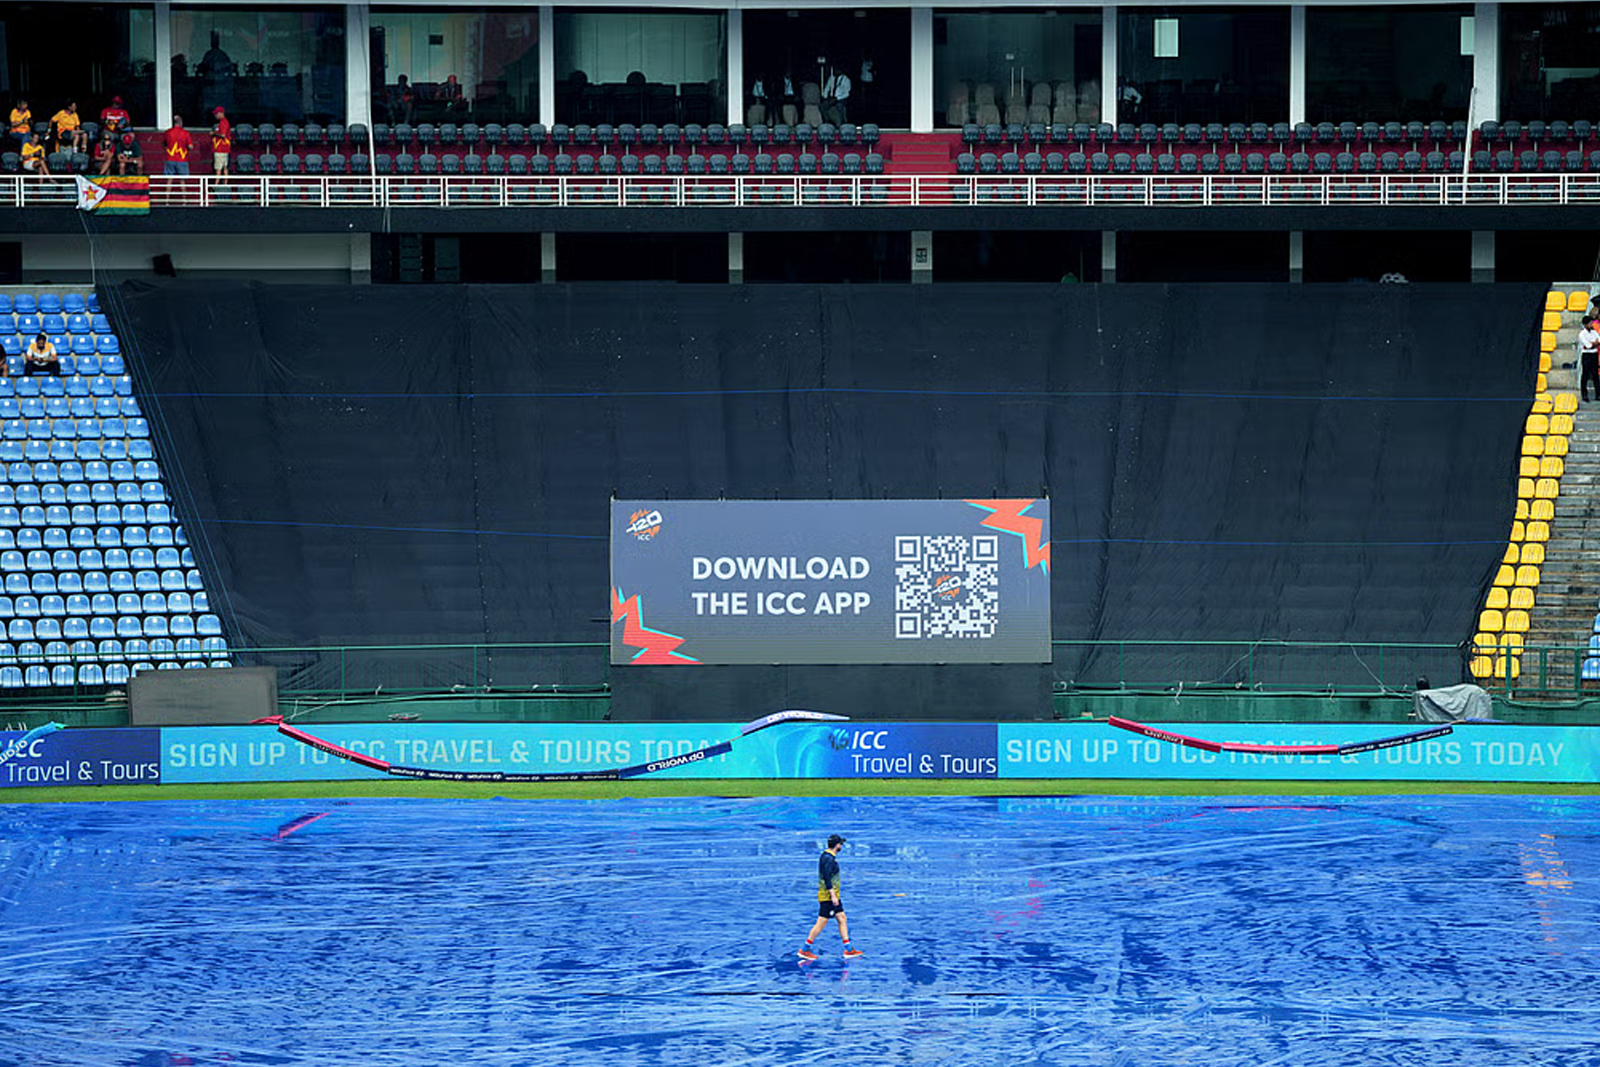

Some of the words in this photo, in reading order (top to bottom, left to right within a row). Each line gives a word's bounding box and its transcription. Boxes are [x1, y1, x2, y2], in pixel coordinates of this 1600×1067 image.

[692, 556, 870, 580] DOWNLOAD
[691, 592, 748, 615] THE
[757, 592, 807, 615] ICC
[813, 592, 871, 615] APP
[851, 731, 889, 750] ICC
[169, 743, 237, 767] SIGN
[249, 742, 286, 766] UP
[395, 740, 501, 763] TRAVEL
[510, 740, 529, 763] &
[539, 740, 631, 763] TOURS
[689, 751, 705, 762] DP
[851, 753, 912, 773] Travel
[919, 754, 935, 773] &
[940, 754, 997, 774] Tours
[1006, 739, 1071, 763] SIGN
[1083, 739, 1118, 763] UP
[1127, 739, 1160, 763] TO
[1471, 741, 1564, 766] TODAY
[5, 760, 70, 782] Travel
[77, 761, 93, 780] &
[100, 760, 159, 780] Tours
[646, 756, 689, 772] WORLD
